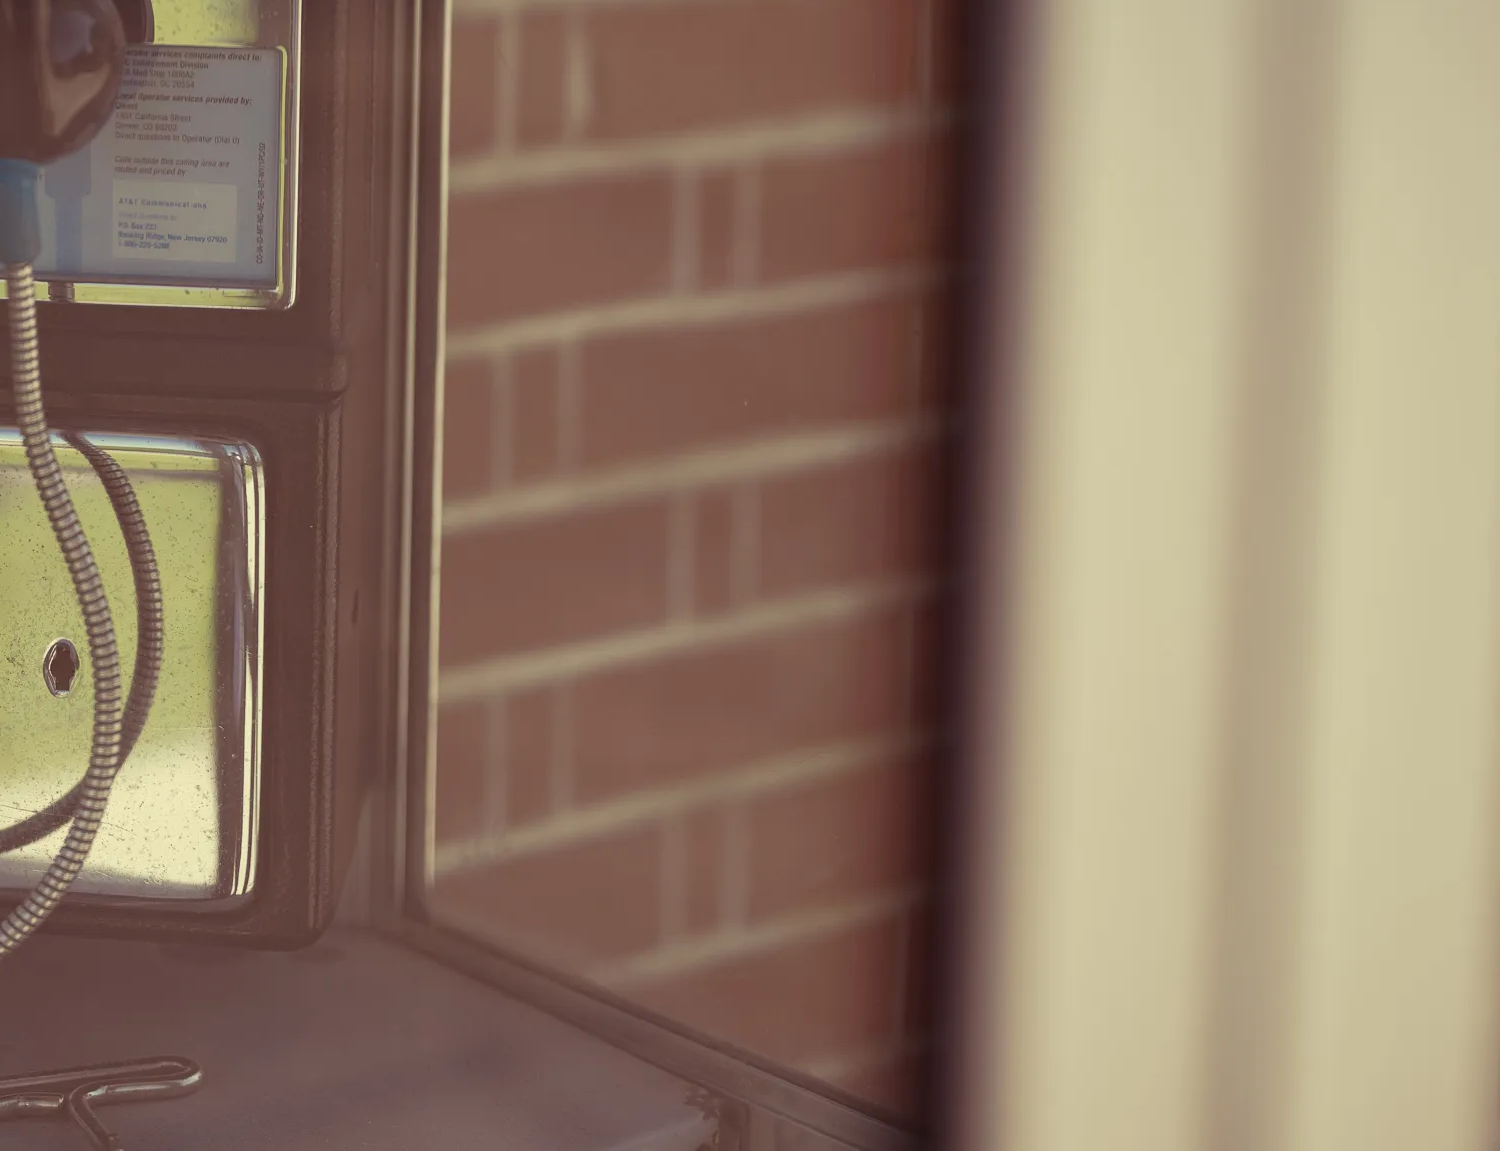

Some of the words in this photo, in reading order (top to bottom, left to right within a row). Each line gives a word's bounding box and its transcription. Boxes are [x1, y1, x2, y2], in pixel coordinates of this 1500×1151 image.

[185, 51, 225, 60] complaints
[228, 53, 249, 61] direct
[206, 96, 238, 105] provided
